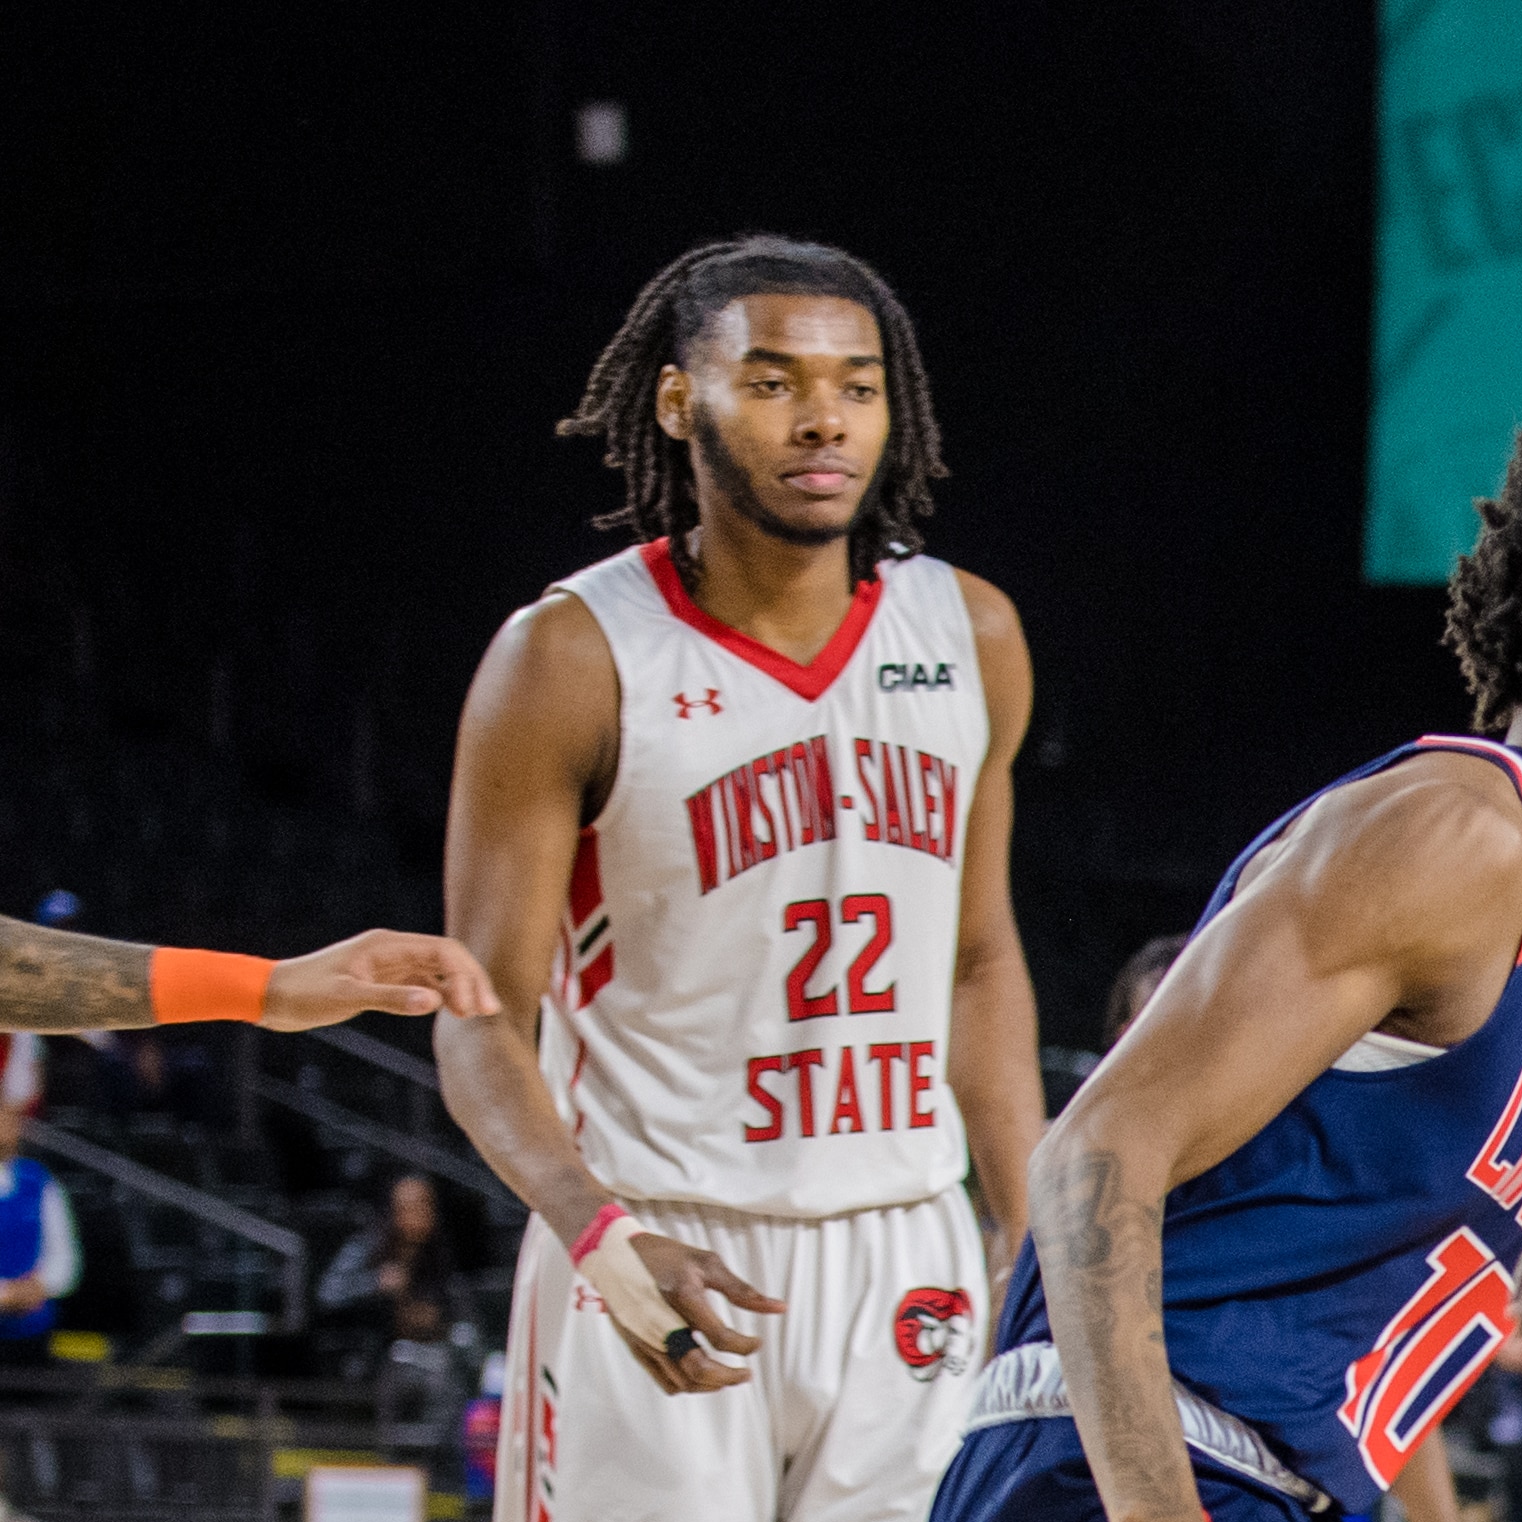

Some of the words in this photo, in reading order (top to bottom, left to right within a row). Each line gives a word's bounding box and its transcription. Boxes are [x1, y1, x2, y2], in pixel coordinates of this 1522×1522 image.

[878, 663, 956, 692] CIAA
[685, 734, 958, 897] WINSTON-SALEM
[783, 893, 896, 1022] 22
[745, 1040, 936, 1142] STATE
[1337, 1225, 1518, 1492] 10
